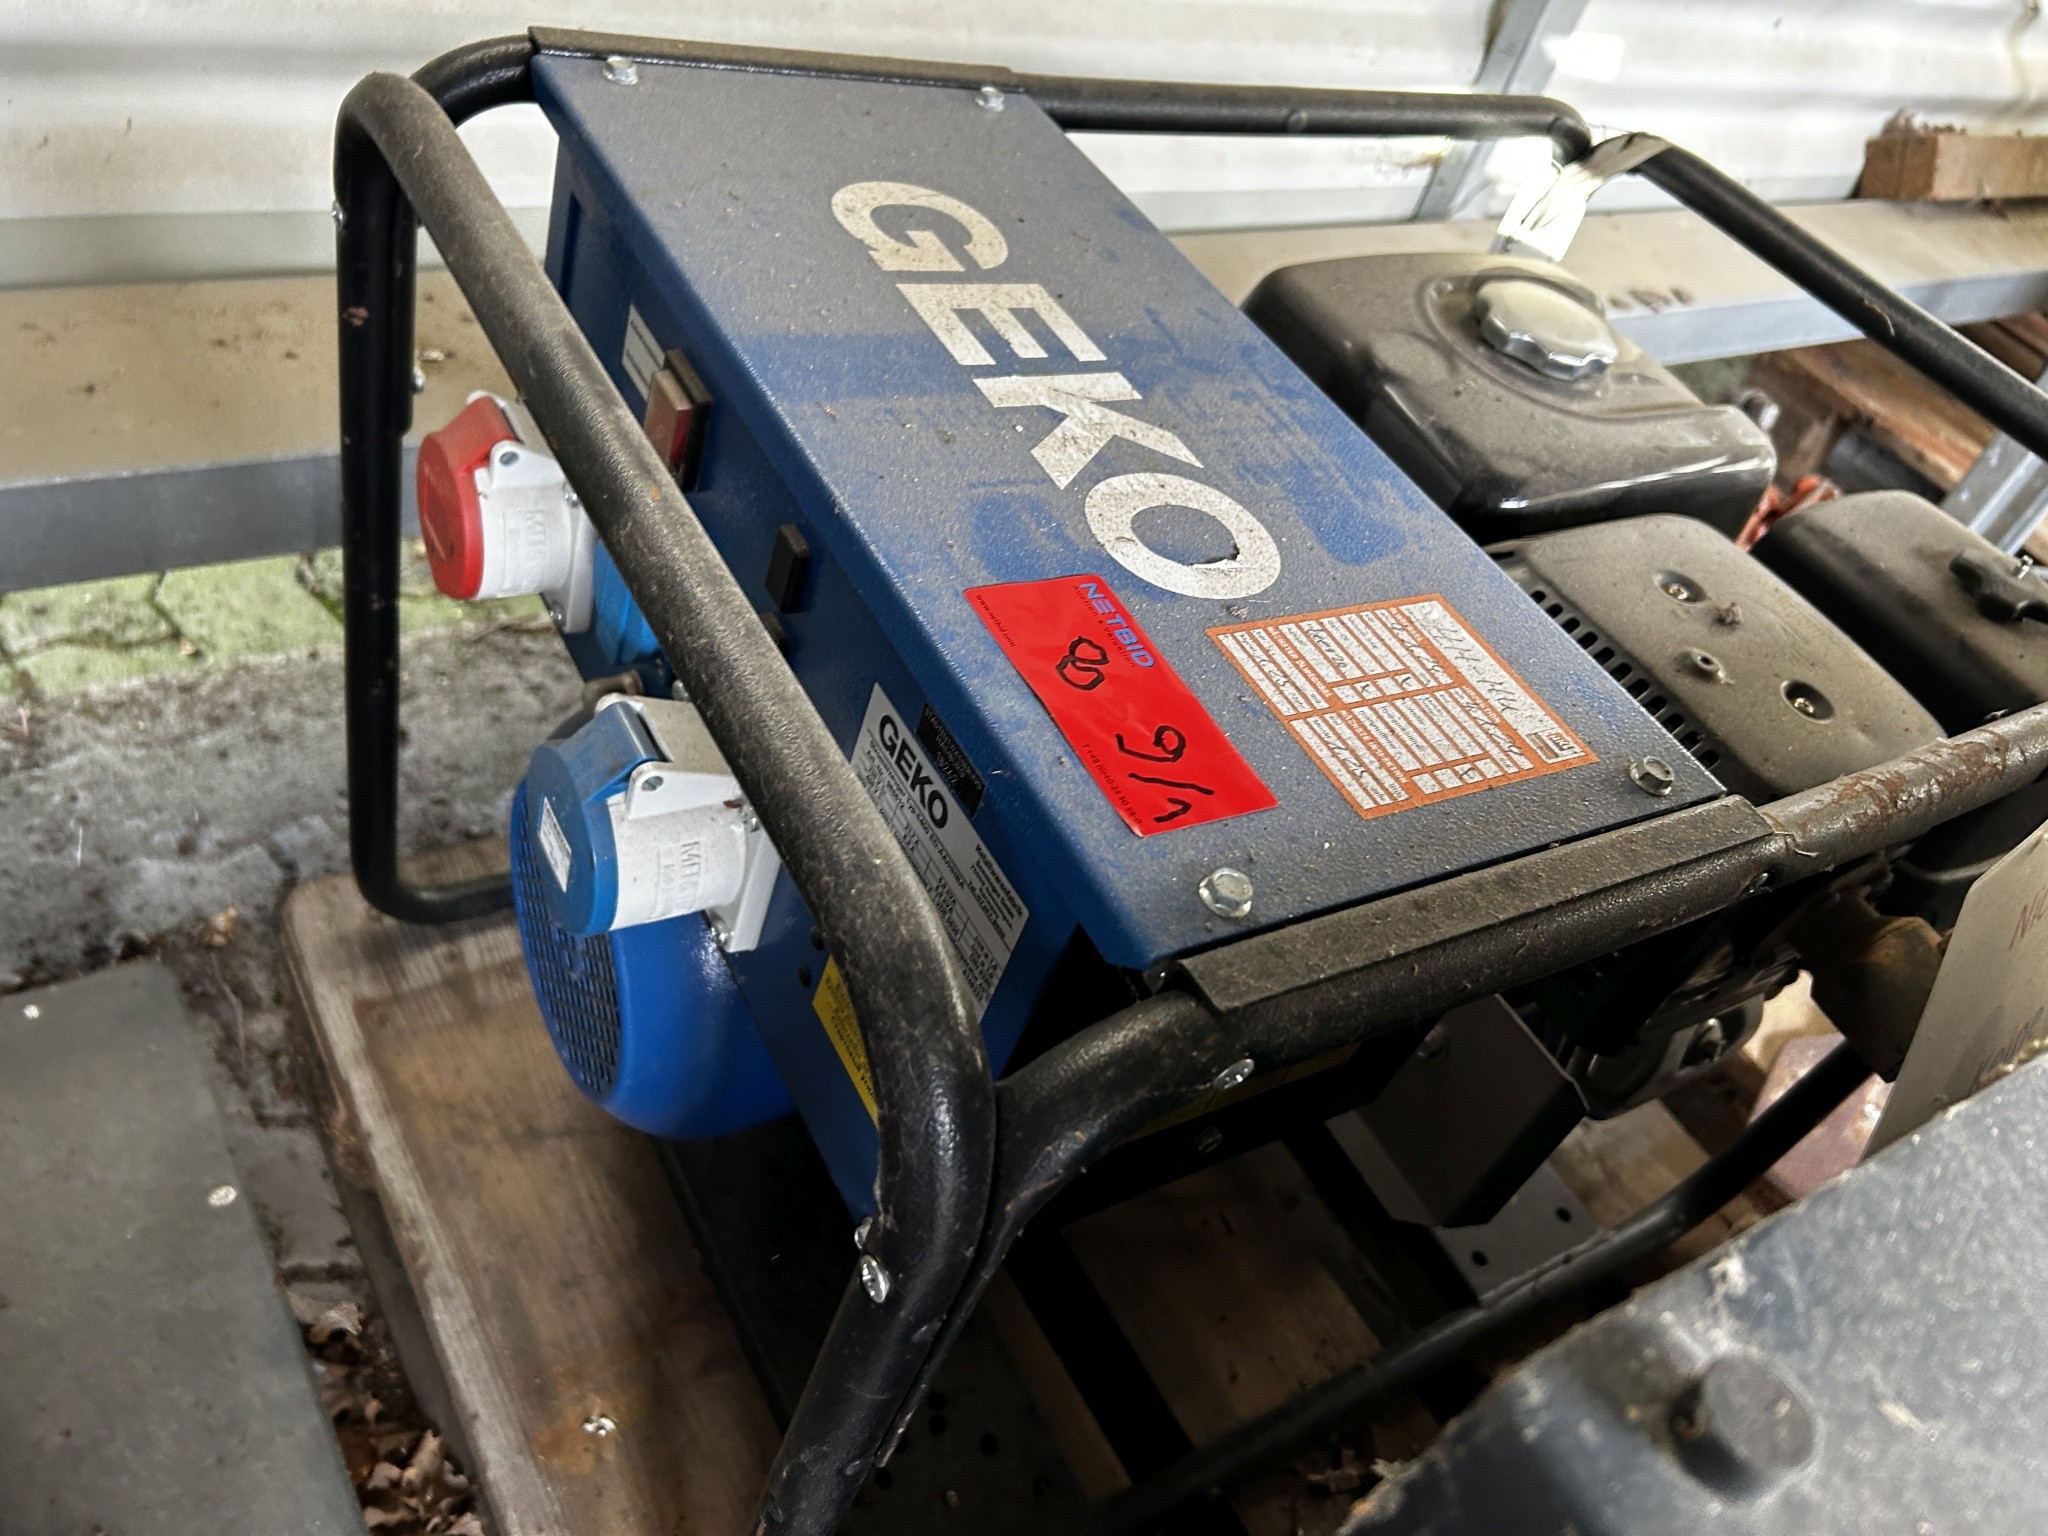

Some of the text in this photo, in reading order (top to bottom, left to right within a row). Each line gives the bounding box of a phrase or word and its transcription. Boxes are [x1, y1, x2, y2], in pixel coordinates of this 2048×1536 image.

[831, 180, 1281, 600] GEKO
[974, 594, 1017, 647] www.netbid.com
[1078, 582, 1155, 667] NETBID
[879, 714, 949, 829] GEKO
